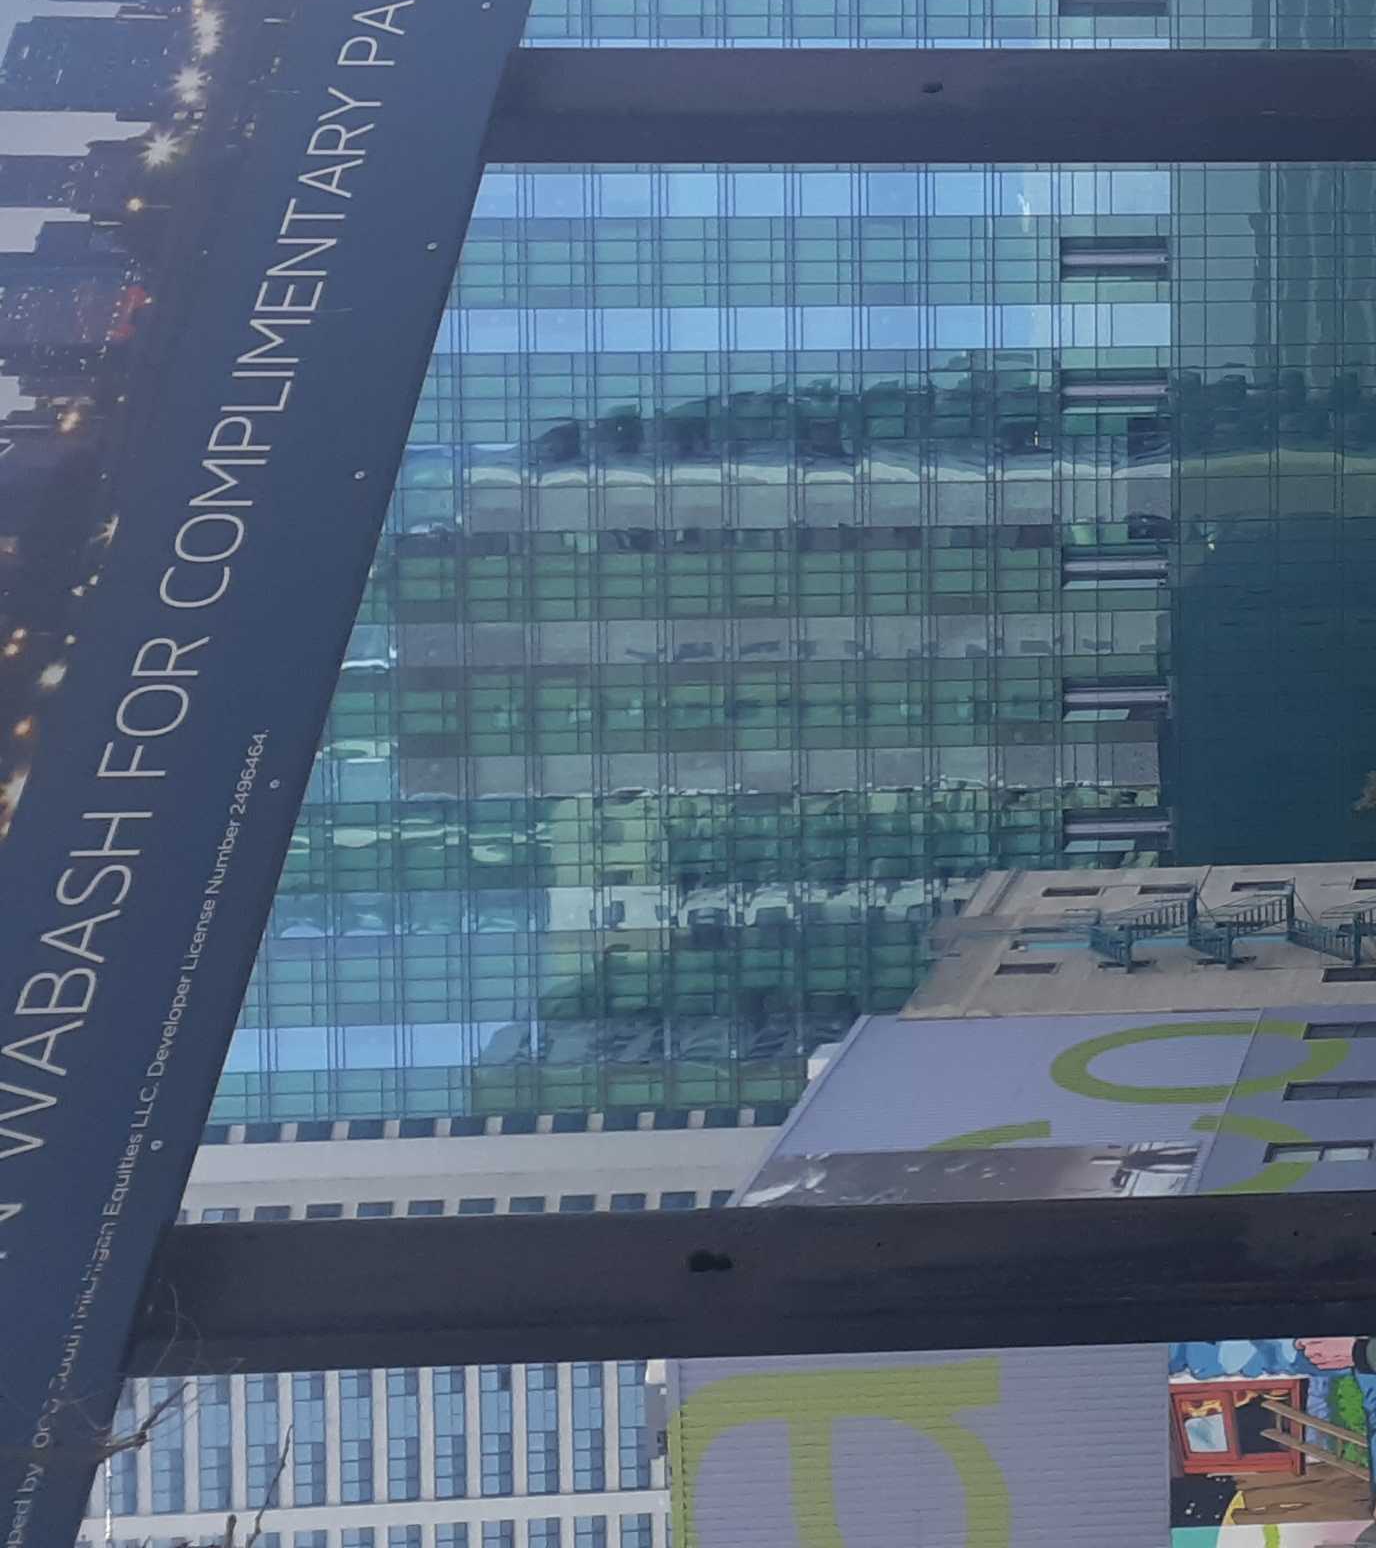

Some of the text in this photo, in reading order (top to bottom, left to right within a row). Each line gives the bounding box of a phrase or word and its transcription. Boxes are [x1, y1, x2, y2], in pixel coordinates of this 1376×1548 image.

[0, 811, 153, 1160] WABASH
[97, 636, 210, 777] FOR
[159, 87, 382, 608] COMPLIMENTARY
[16, 1463, 44, 1493] by
[102, 1134, 143, 1215] Equities
[130, 1082, 160, 1128] LLC.
[146, 976, 193, 1077] Developer
[179, 899, 216, 970] License
[203, 820, 241, 894] Number
[228, 729, 270, 815] 2496464.
